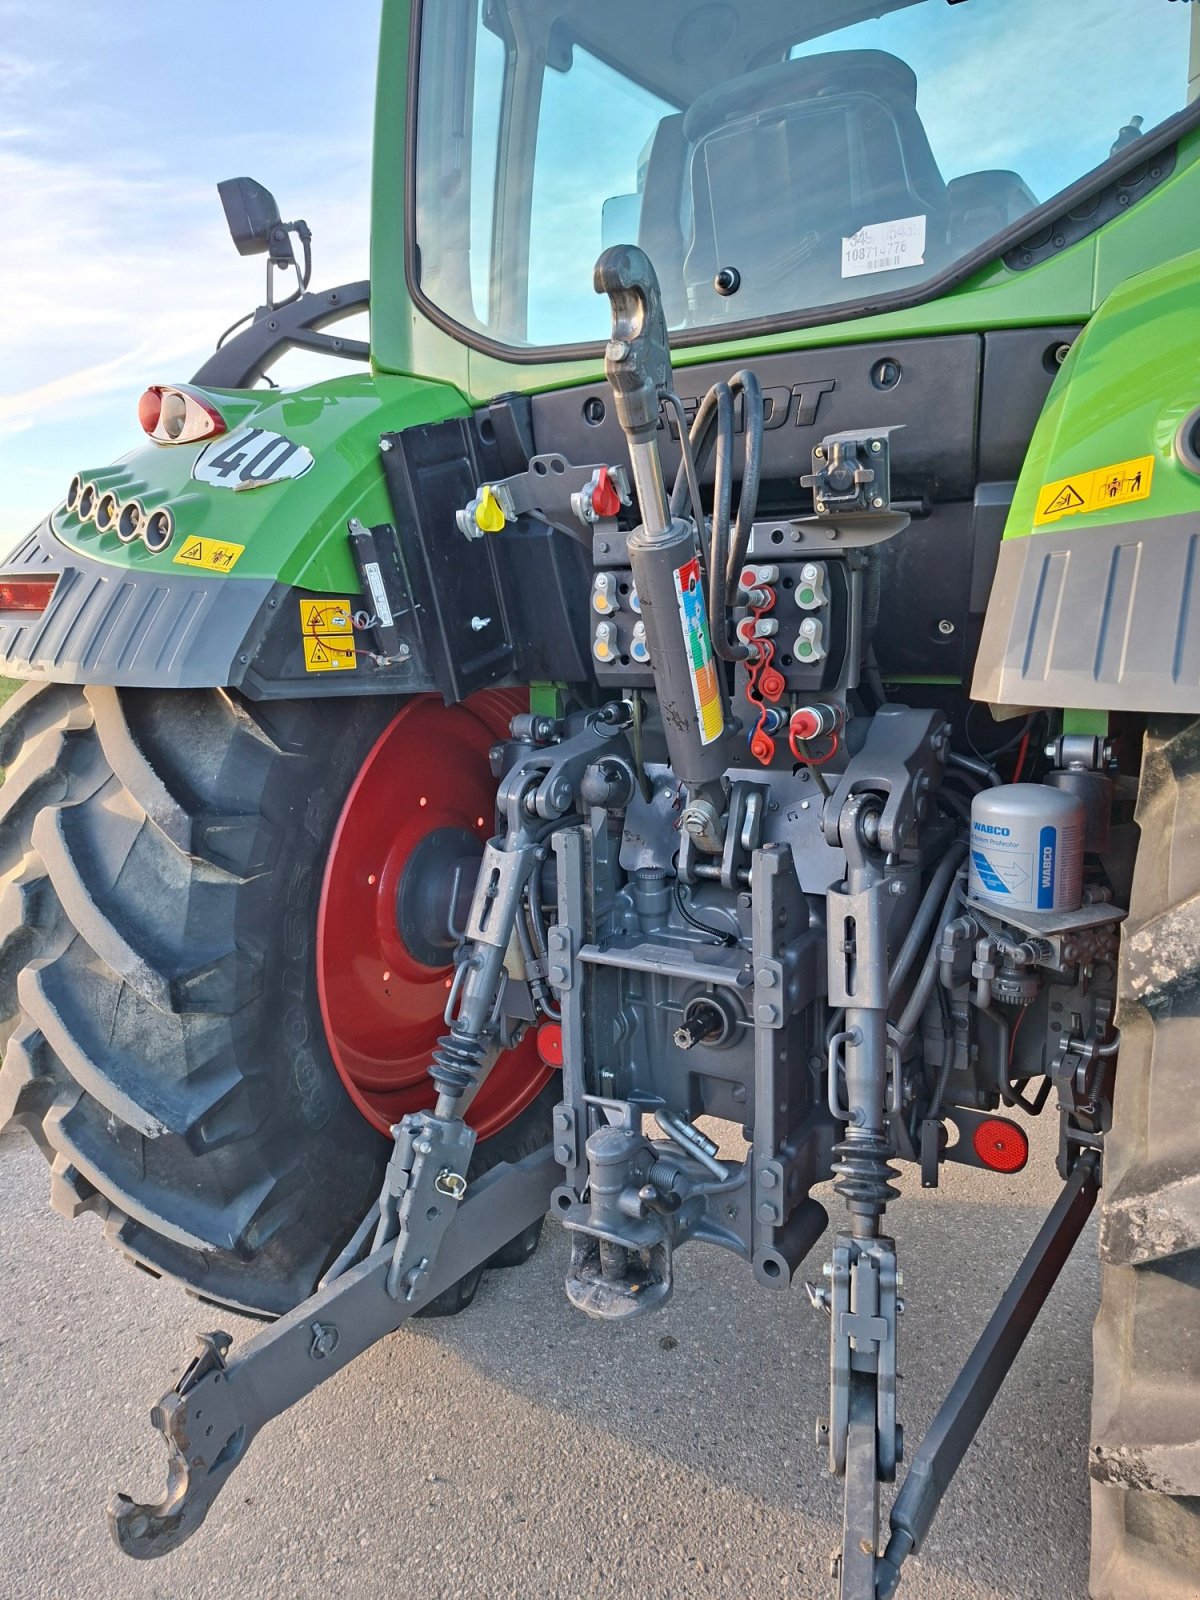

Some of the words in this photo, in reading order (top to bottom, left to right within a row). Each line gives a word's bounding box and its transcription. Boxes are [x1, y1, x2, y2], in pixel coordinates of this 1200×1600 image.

[208, 428, 299, 482] 40
[974, 821, 1010, 836] WABCO
[1042, 847, 1053, 888] WABCO
